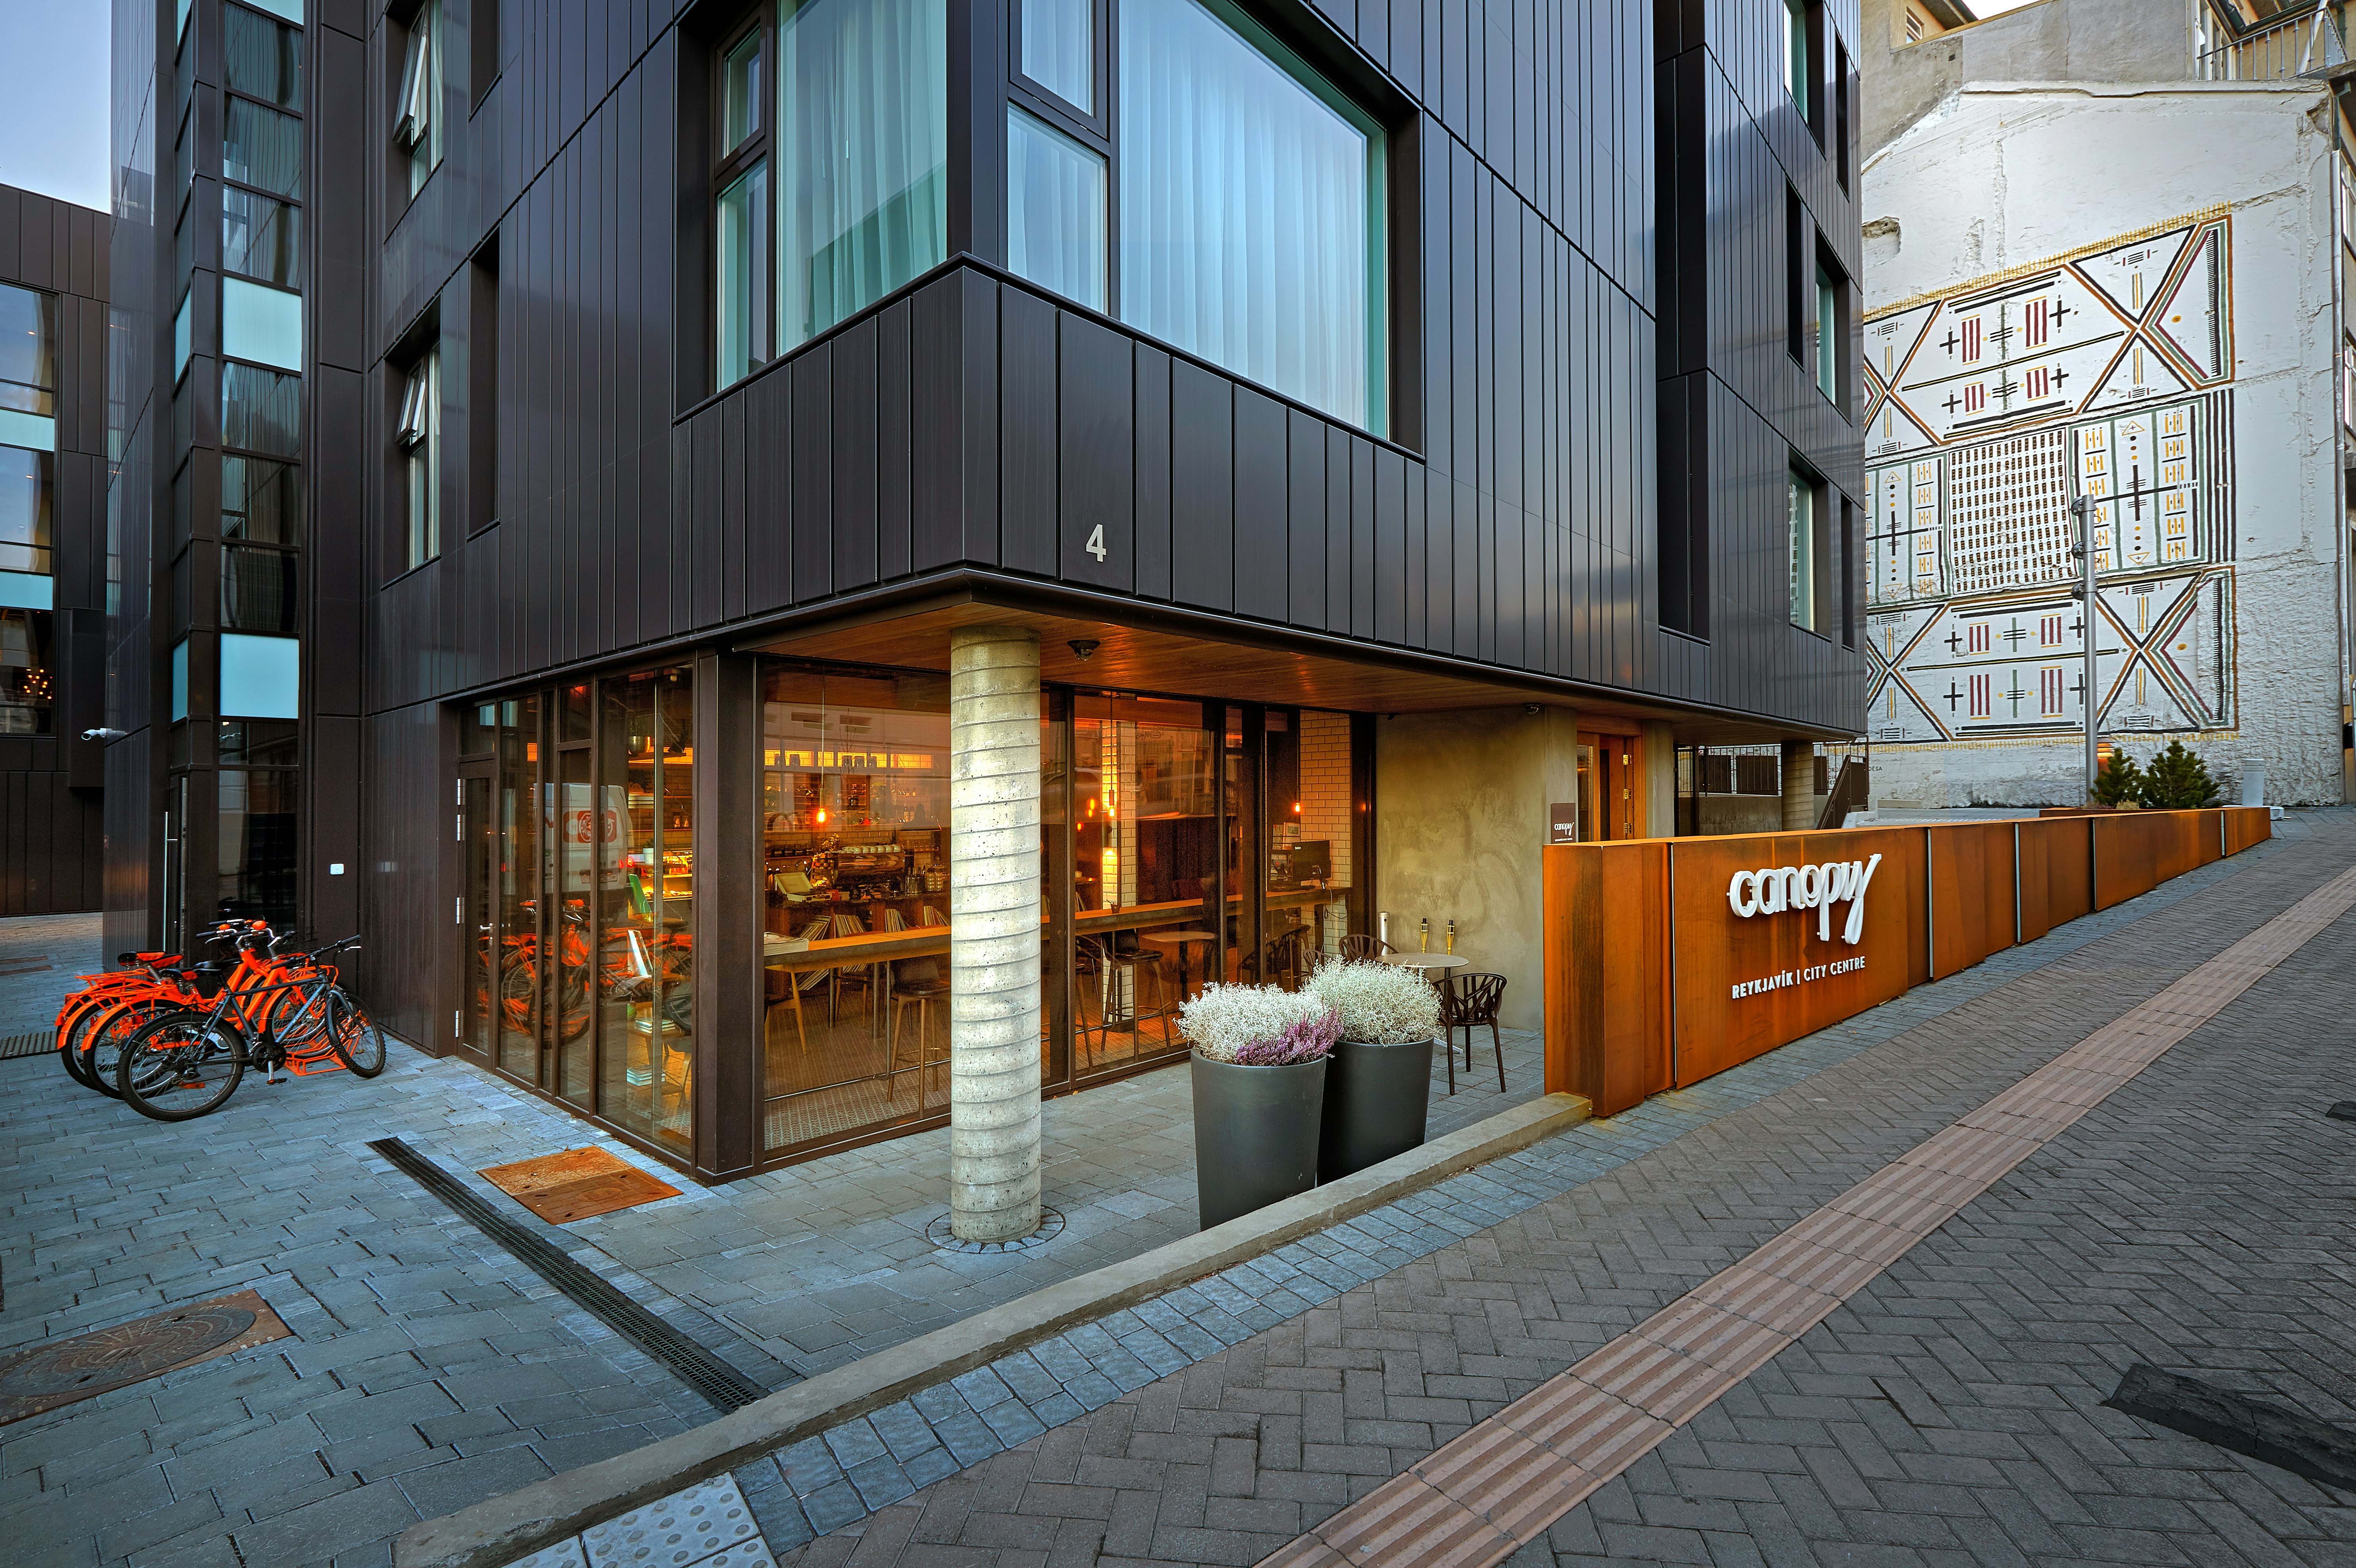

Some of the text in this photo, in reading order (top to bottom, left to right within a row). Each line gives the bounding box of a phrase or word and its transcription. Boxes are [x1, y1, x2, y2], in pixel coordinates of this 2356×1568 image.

[1086, 523, 1106, 562] 4
[1554, 822, 1575, 836] canopy
[1729, 853, 1882, 945] canopy
[1732, 970, 1793, 999] REYKJAVÍK
[1803, 964, 1826, 981] CITY
[1830, 955, 1866, 975] CENTRE
